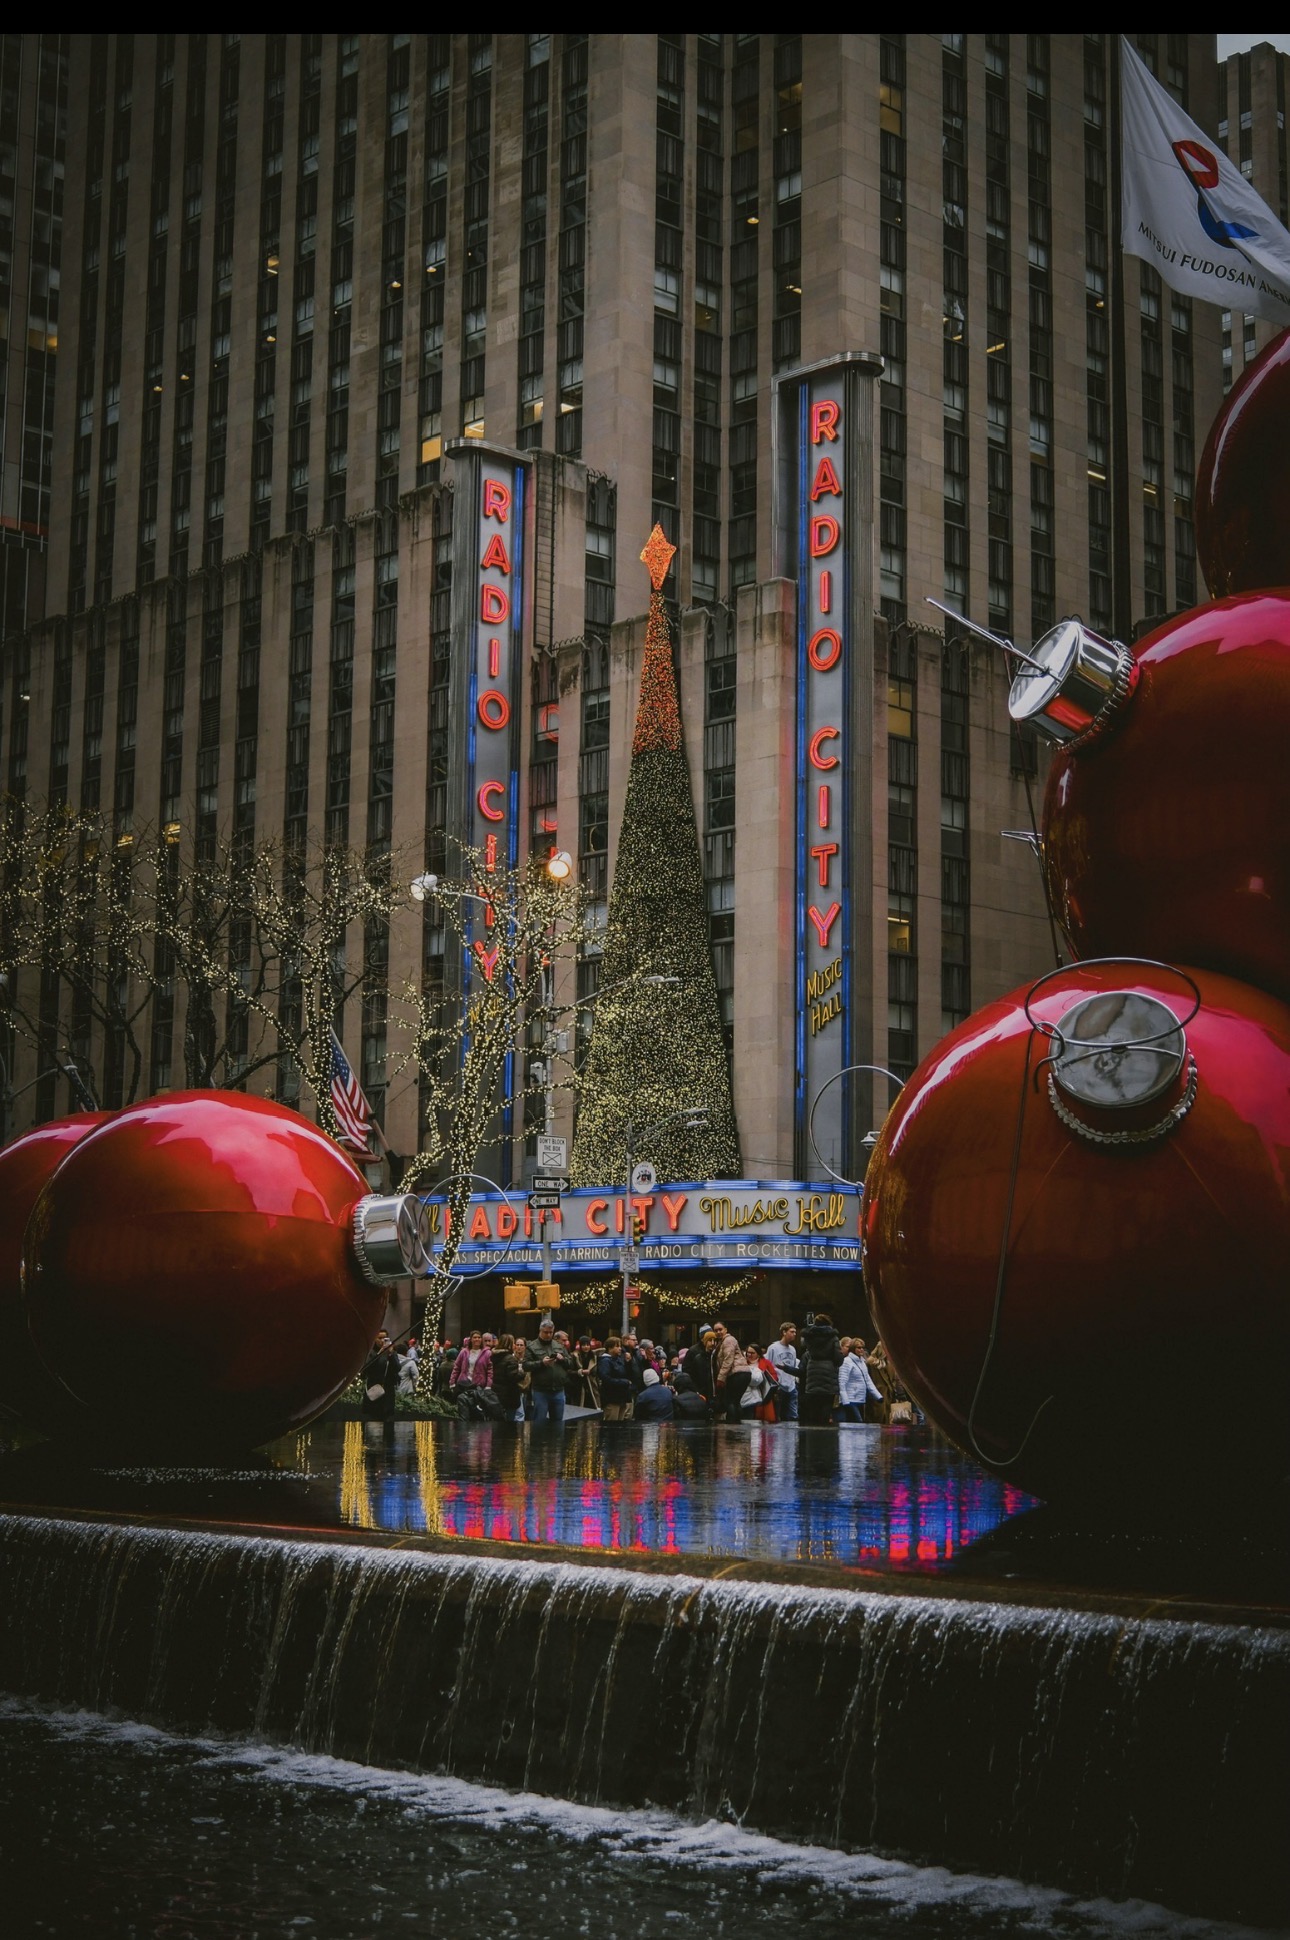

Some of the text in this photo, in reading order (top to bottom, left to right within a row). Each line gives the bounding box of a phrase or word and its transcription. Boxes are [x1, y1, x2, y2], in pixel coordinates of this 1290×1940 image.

[1138, 221, 1177, 263] MITSUI
[1180, 254, 1256, 288] FUDOSAN
[477, 478, 511, 731] RADIO
[808, 400, 843, 947] RADIO CITY
[807, 957, 842, 1006] MUSIC
[811, 991, 842, 1036] HALL
[586, 1193, 688, 1235] CITY
[700, 1196, 789, 1232] Music
[783, 1193, 846, 1235] Hall
[556, 1247, 609, 1261] STARRING
[645, 1244, 682, 1258] RADIO
[690, 1244, 726, 1258] CITY
[736, 1243, 826, 1259] ROCKETTES
[833, 1247, 859, 1260] NOW
